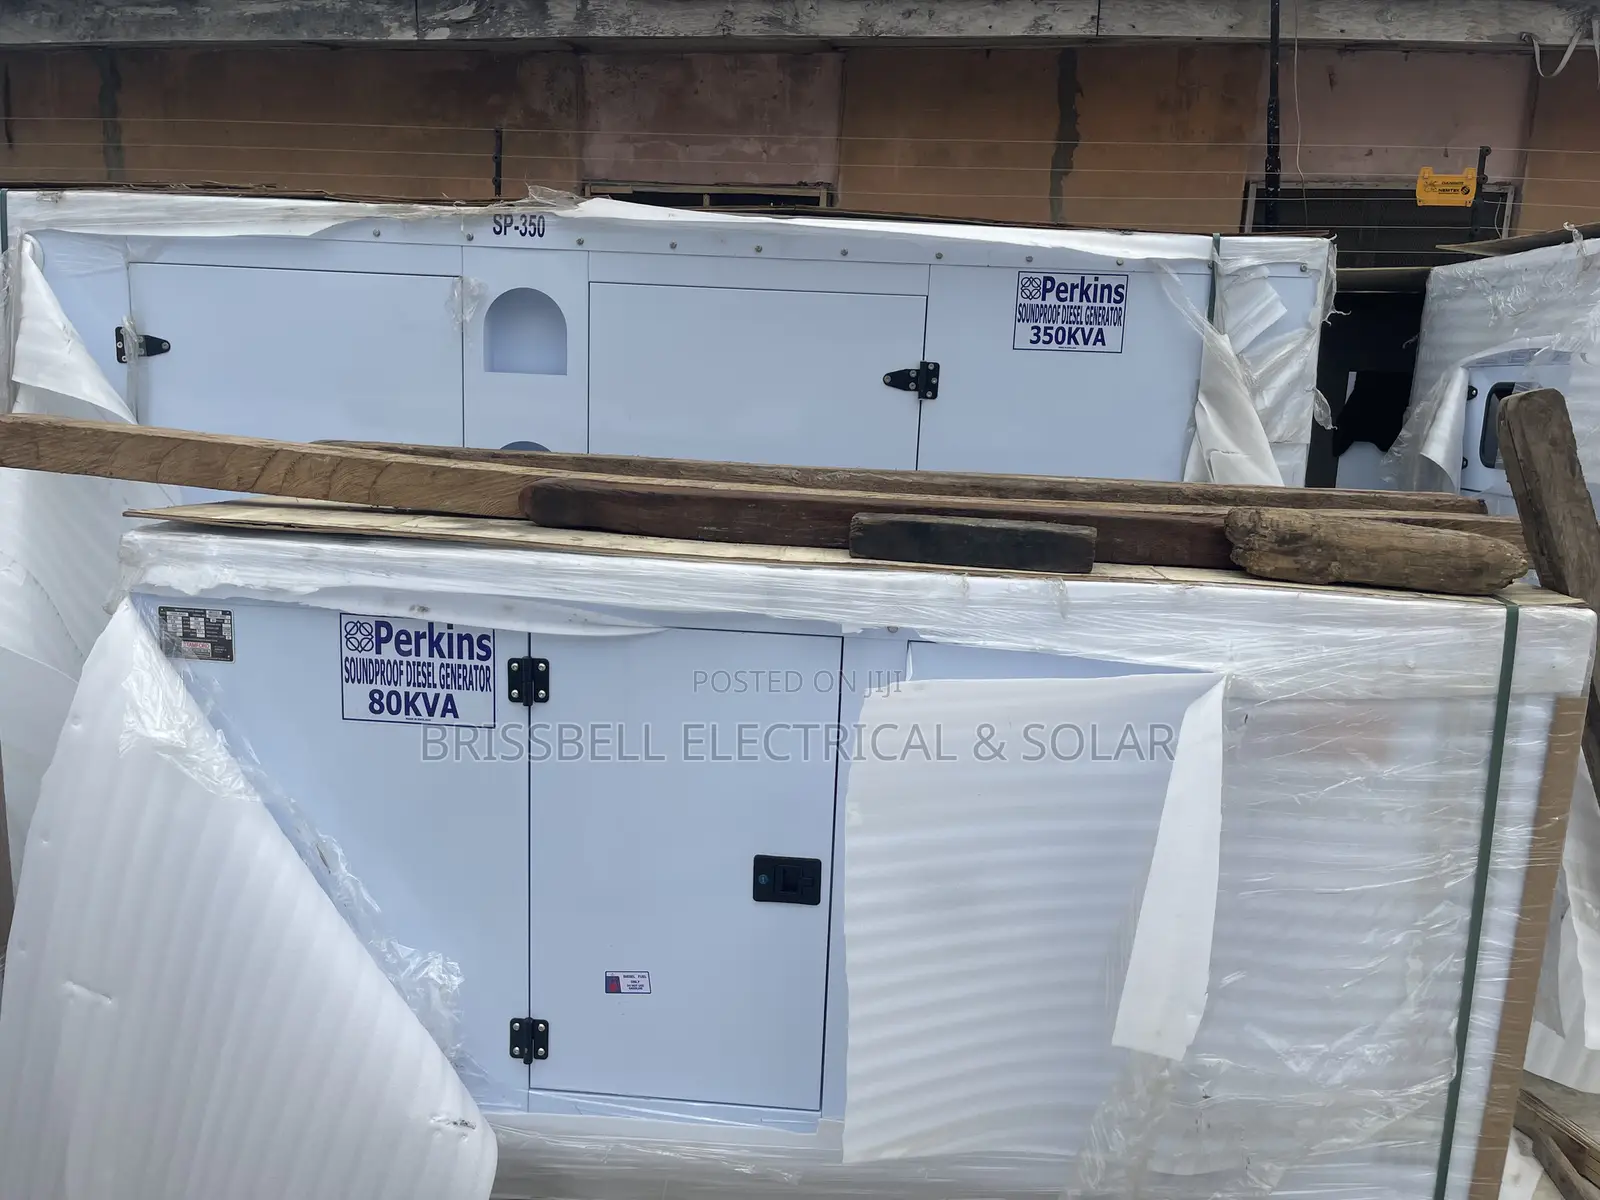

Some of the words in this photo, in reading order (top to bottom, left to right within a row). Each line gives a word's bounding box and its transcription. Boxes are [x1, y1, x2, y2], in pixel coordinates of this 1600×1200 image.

[493, 213, 545, 238] SP-350
[1041, 275, 1125, 304] Perkins
[1017, 303, 1061, 324] SOUNDPROOF
[1061, 305, 1083, 325] DIESEL
[1084, 306, 1122, 327] GENERATOR
[1029, 325, 1106, 346] 350KVA
[374, 620, 492, 661] Perkins
[344, 656, 404, 687] SOUNDPROOF
[405, 660, 437, 689] DIESEL
[439, 663, 492, 692] GENERATOR
[368, 689, 460, 719] 80KVA
